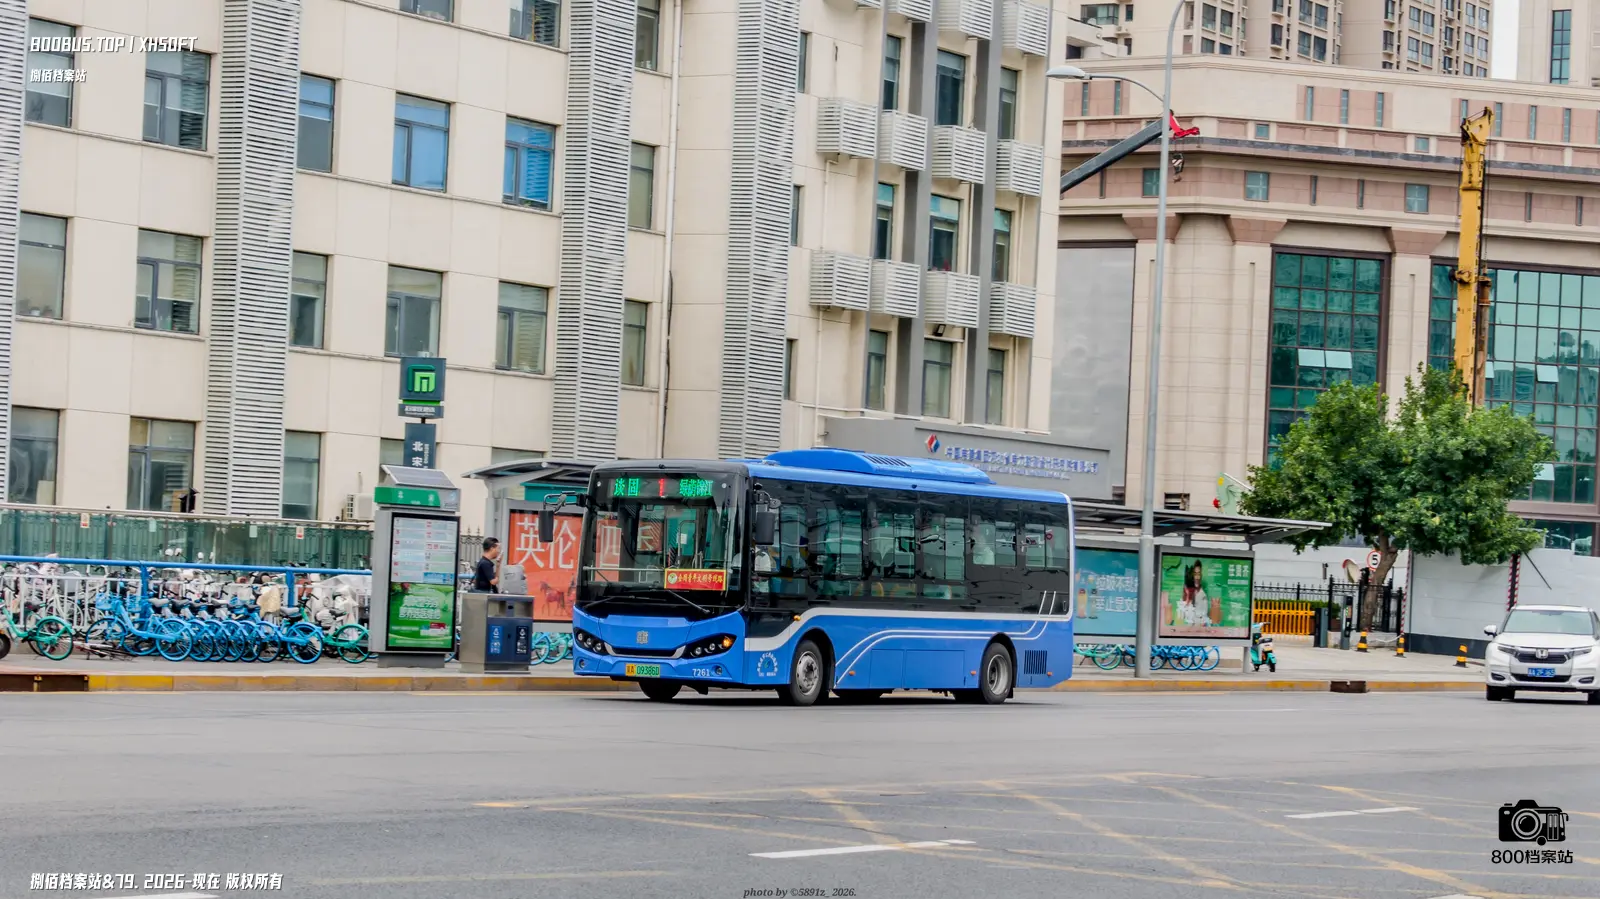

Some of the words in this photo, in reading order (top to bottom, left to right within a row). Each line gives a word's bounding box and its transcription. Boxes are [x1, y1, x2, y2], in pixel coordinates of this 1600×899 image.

[613, 477, 640, 497] 谈固
[658, 478, 665, 497] 1
[1372, 554, 1379, 566] 5
[692, 668, 710, 676] 7261
